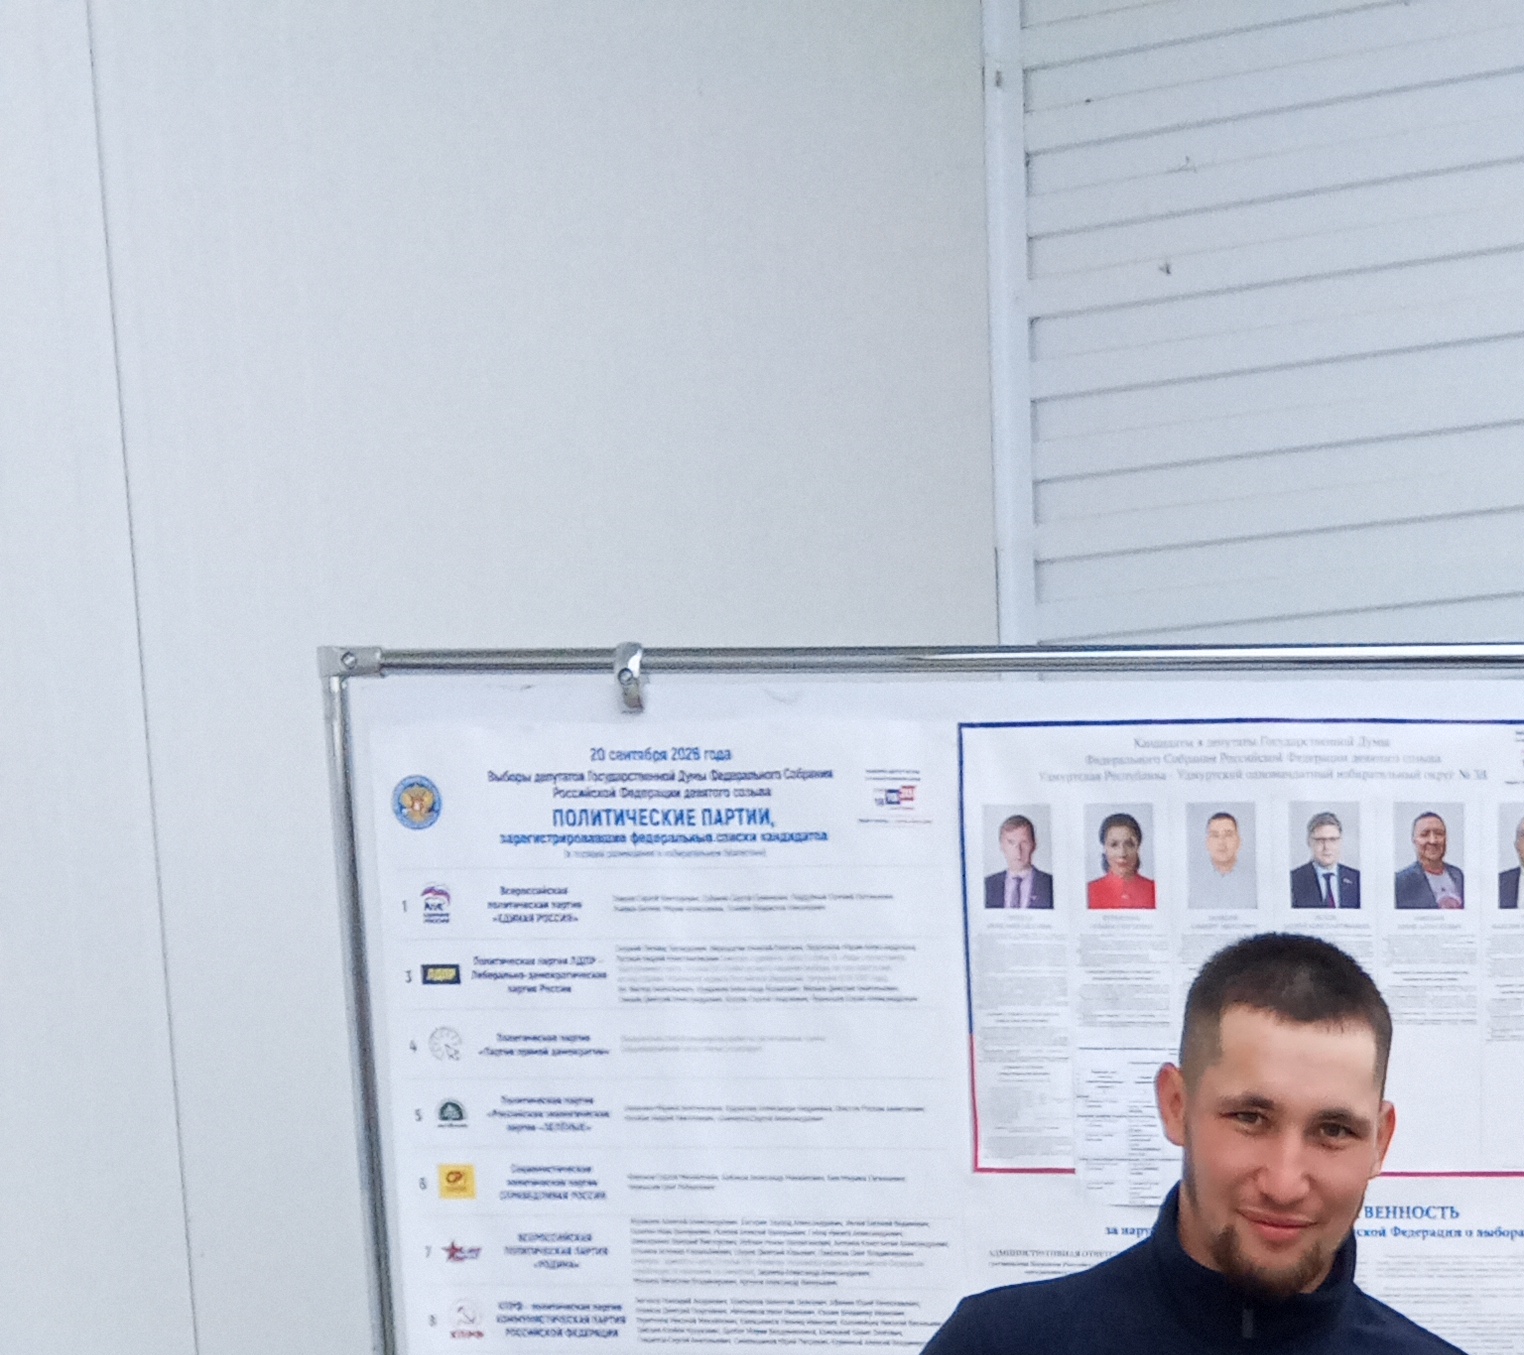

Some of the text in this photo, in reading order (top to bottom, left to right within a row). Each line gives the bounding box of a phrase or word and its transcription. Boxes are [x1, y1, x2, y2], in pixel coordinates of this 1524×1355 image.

[590, 747, 605, 762] 20
[609, 747, 668, 763] сентября
[704, 749, 732, 762] года
[553, 786, 616, 799] Российской
[552, 807, 776, 829] ПОЛИТИЧЕСКИЕ ПАРТИИ,
[1357, 1205, 1460, 1220] ВЕННОСТЬ
[1104, 1226, 1118, 1236] за
[1121, 1226, 1152, 1238] нару
[1355, 1225, 1387, 1238] ской
[1390, 1226, 1462, 1239] Федерации
[1465, 1229, 1473, 1238] о
